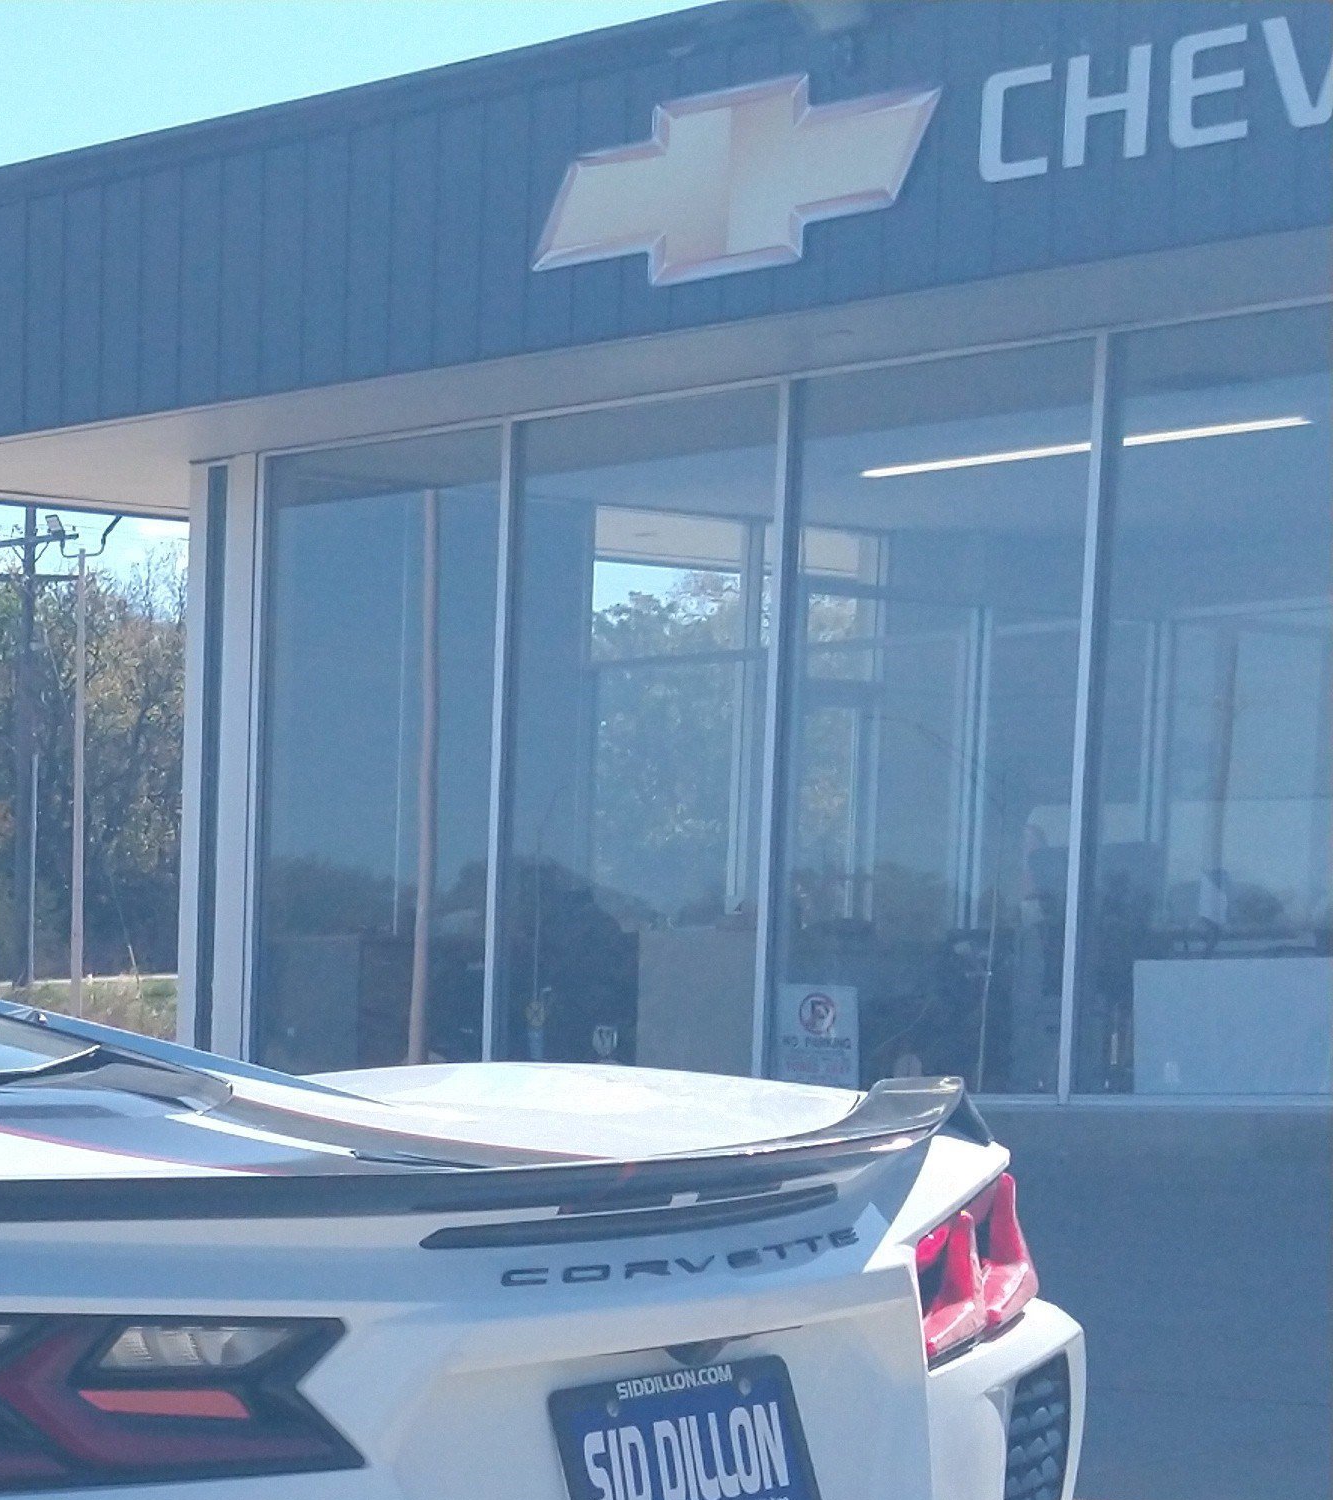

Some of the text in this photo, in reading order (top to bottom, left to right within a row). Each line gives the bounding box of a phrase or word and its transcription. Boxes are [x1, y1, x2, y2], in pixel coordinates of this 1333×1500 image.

[979, 16, 1333, 183] CHEV
[500, 1227, 860, 1287] CORVETTE
[615, 1363, 733, 1400] SIDDILLON.COM
